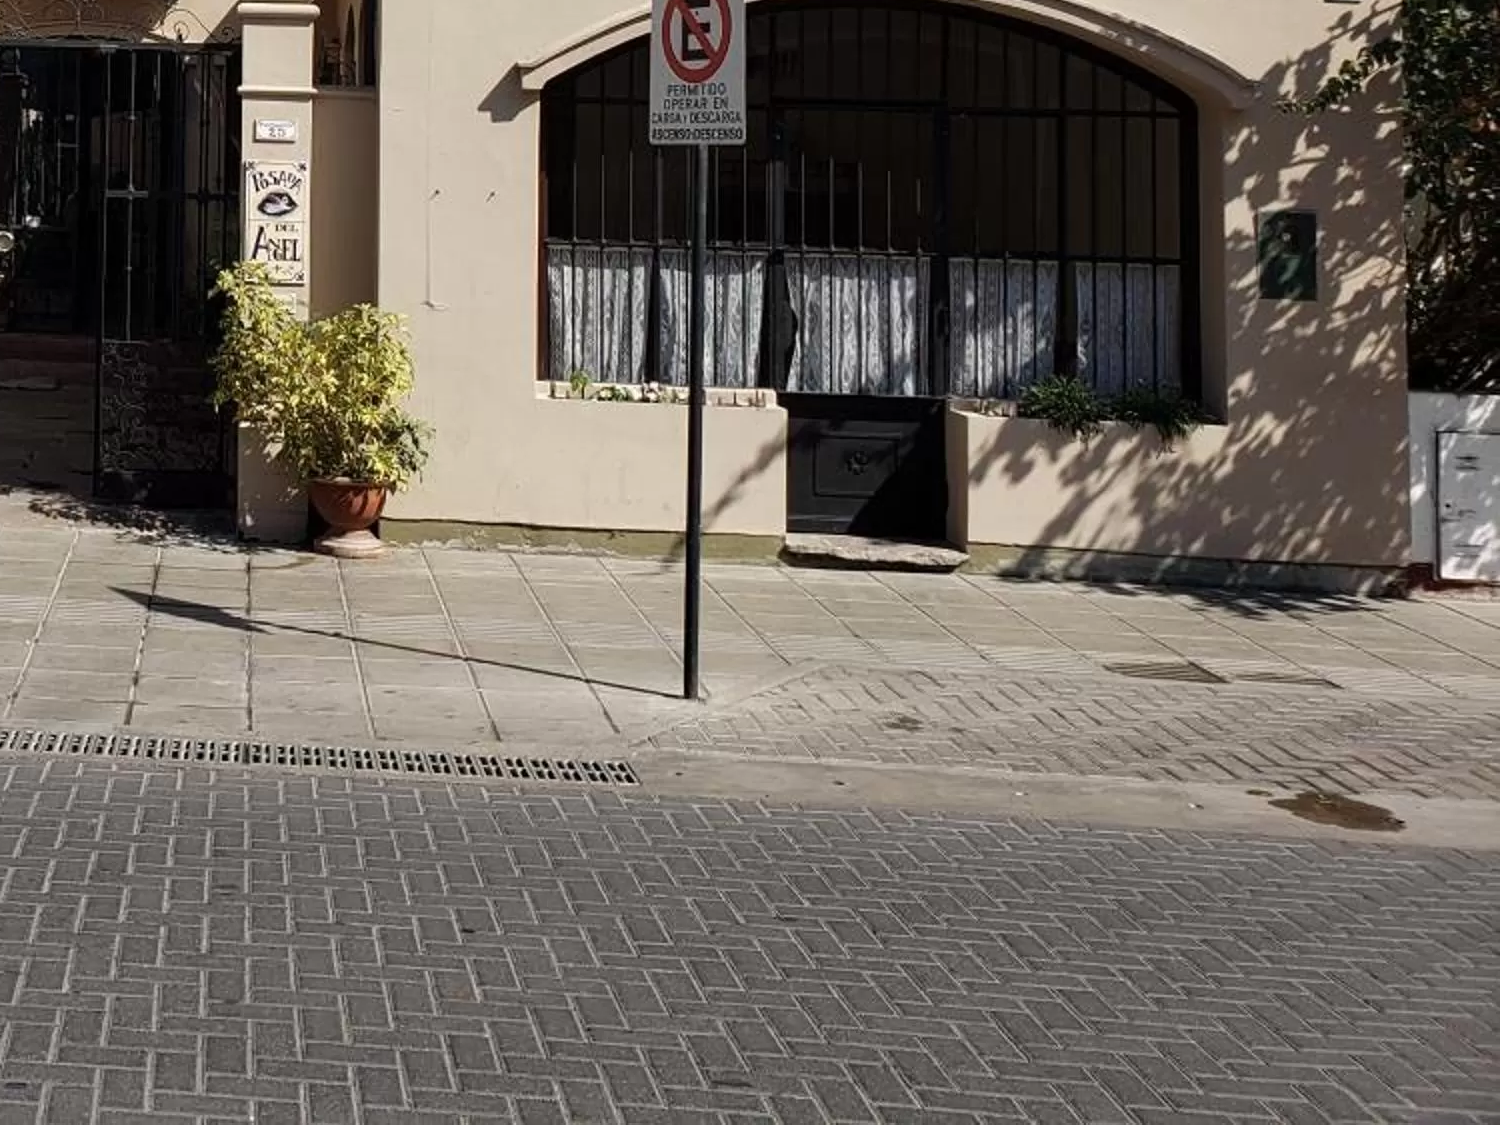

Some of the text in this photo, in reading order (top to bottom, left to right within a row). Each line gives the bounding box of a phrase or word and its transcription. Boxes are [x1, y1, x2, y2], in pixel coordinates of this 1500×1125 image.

[666, 82, 727, 97] PERMITIDO
[663, 97, 729, 110] OPERAR EN
[651, 112, 682, 124] CARGA
[689, 110, 743, 124] DESCARGA
